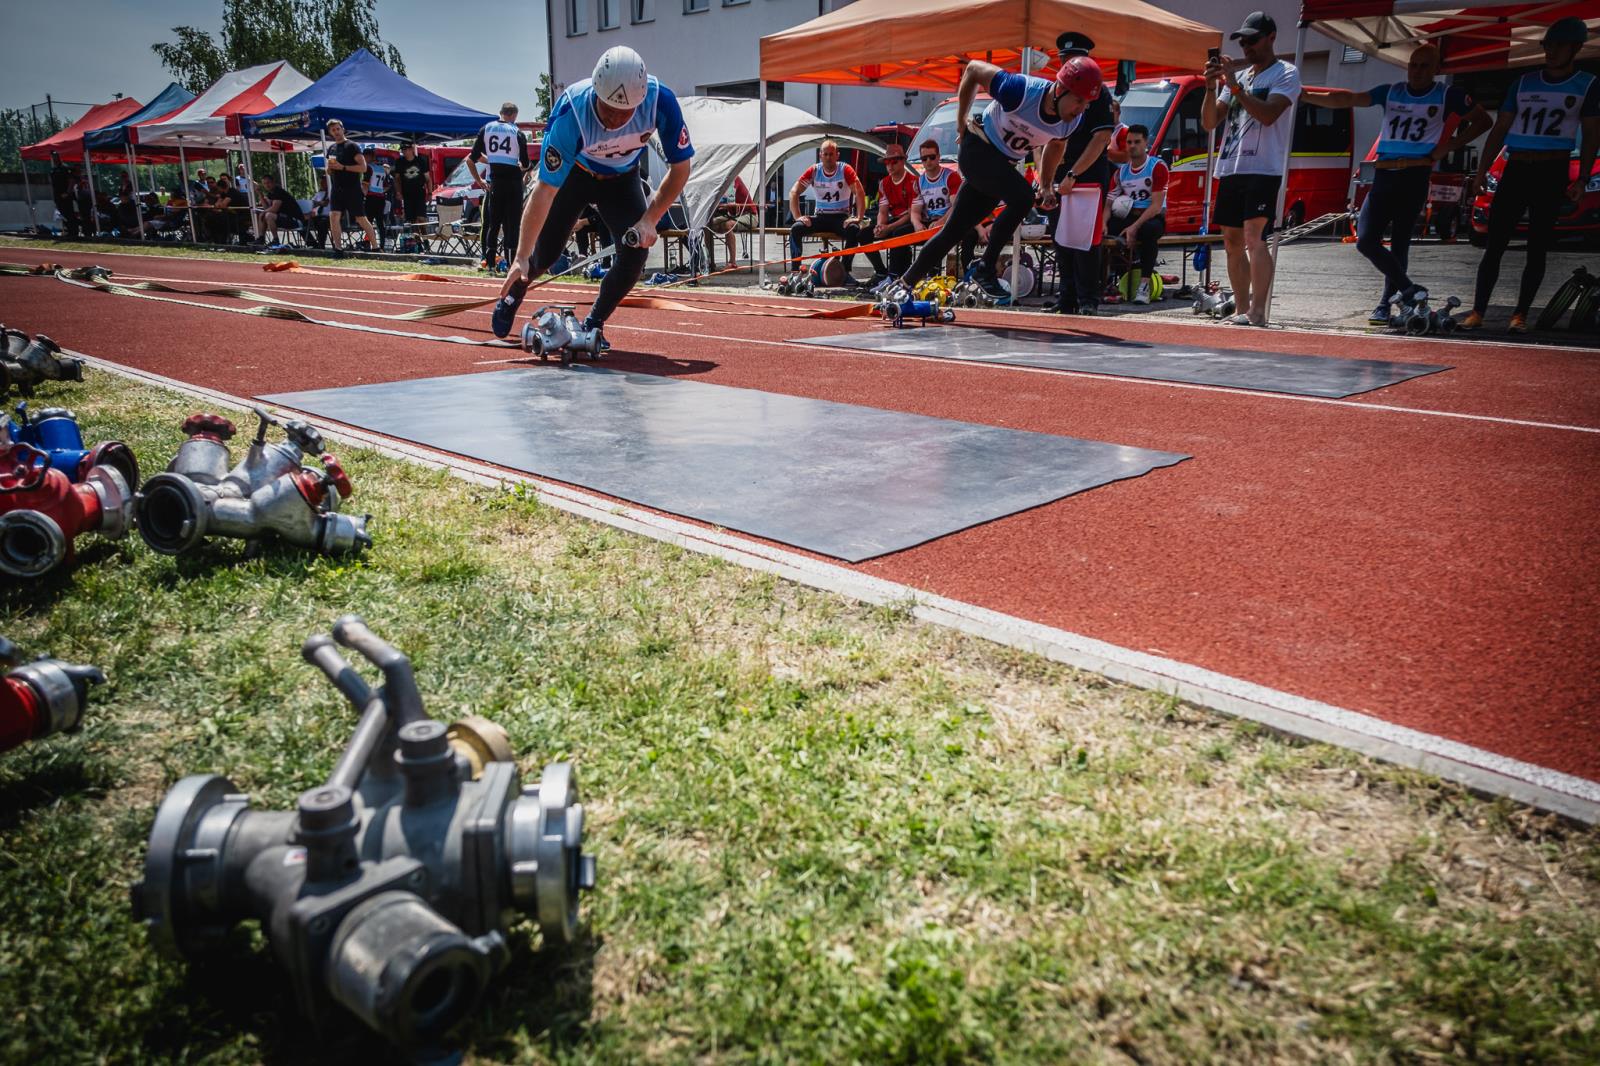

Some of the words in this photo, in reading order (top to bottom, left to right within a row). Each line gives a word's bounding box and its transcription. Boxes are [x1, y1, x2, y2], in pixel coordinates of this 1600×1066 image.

[1389, 115, 1427, 142] 113
[1520, 107, 1566, 136] 112
[488, 134, 512, 154] 64
[1002, 127, 1034, 151] 10
[822, 190, 840, 202] 41
[927, 197, 946, 210] 48
